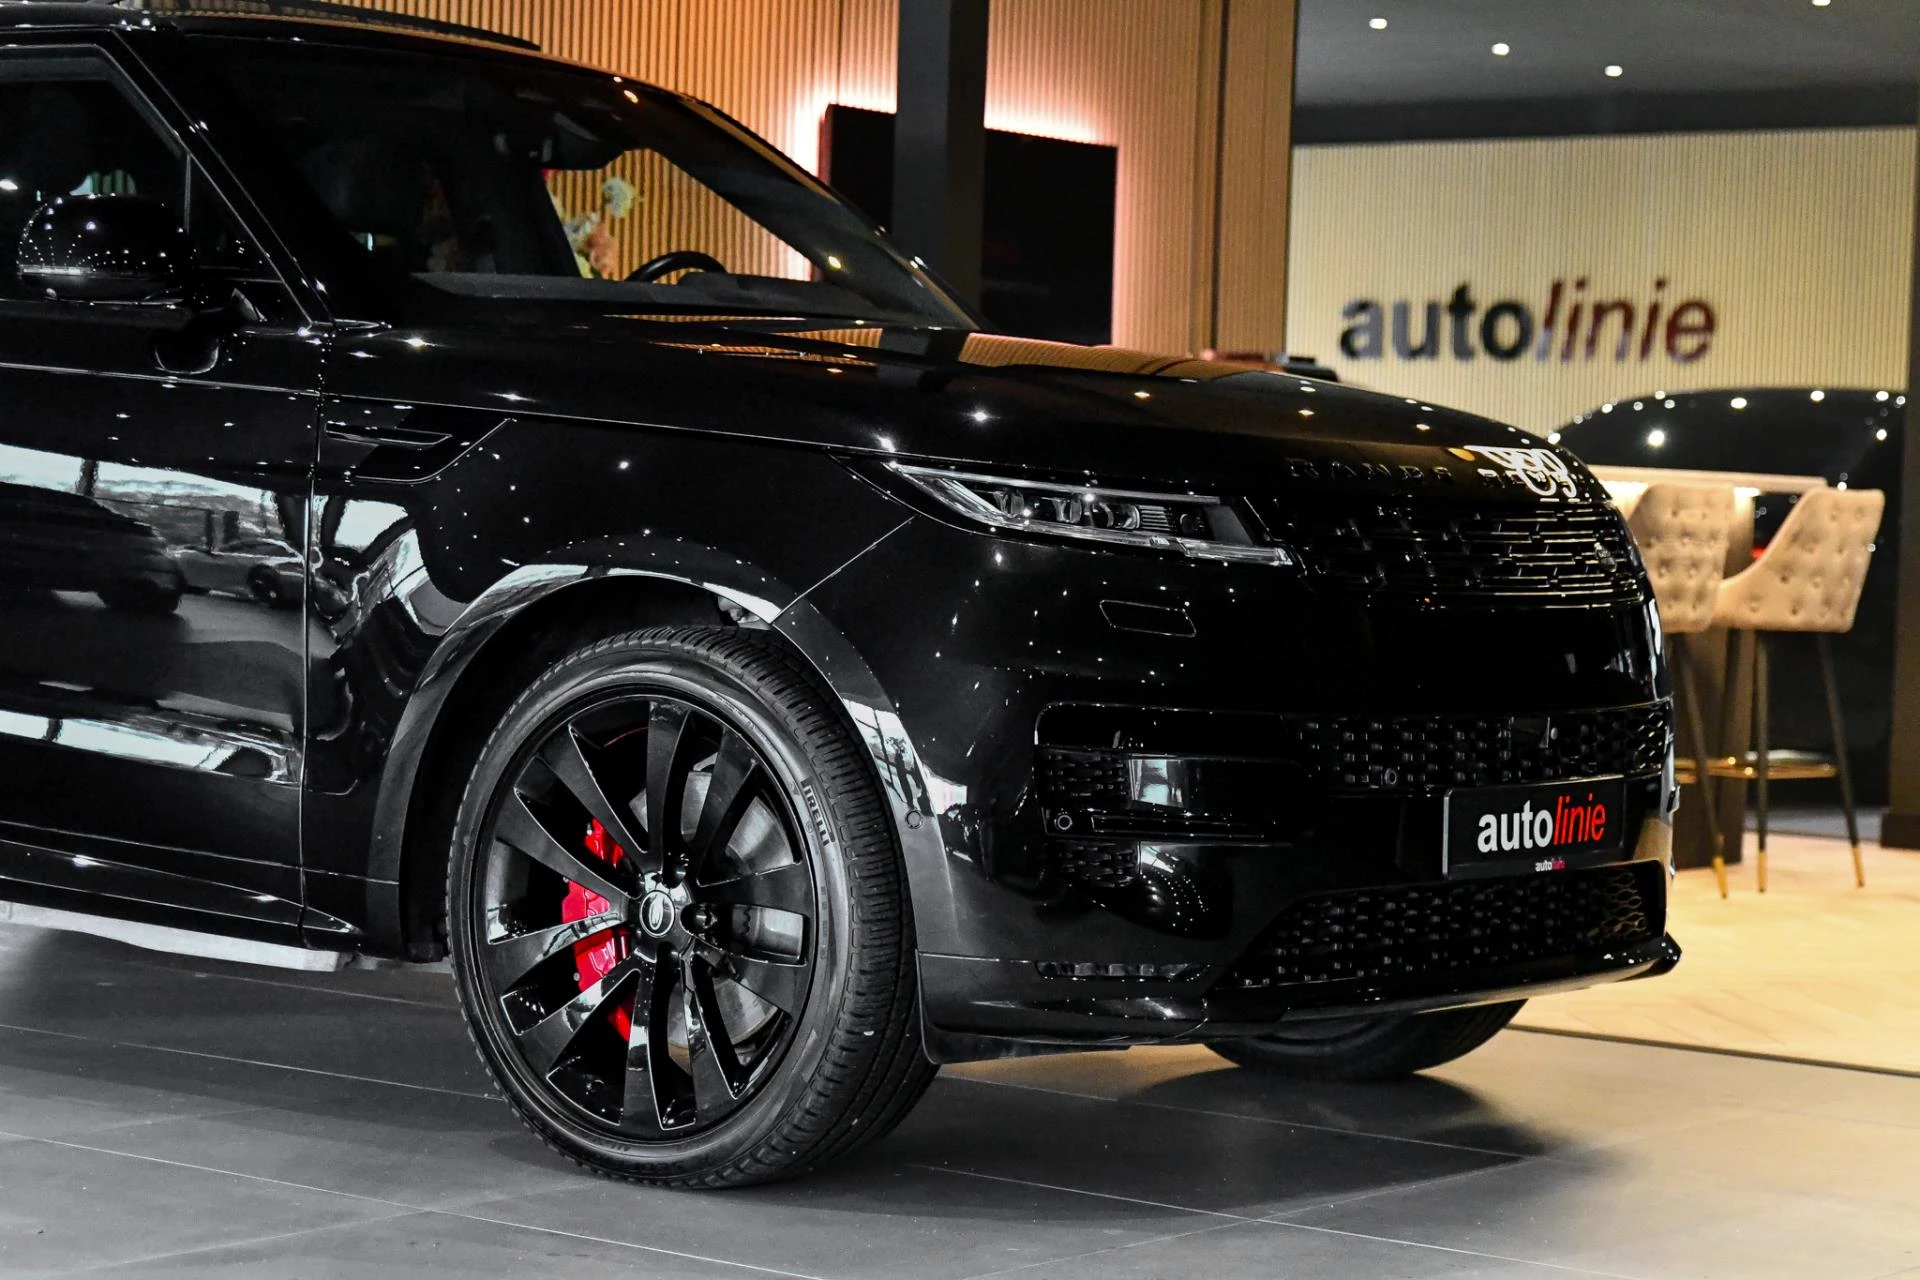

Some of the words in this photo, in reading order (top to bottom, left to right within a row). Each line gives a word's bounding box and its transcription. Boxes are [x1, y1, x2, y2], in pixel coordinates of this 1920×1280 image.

[1339, 276, 1716, 363] autolinie
[801, 776, 836, 847] PIRELLI
[1477, 793, 1606, 853] autolinie
[1535, 857, 1566, 871] autol
